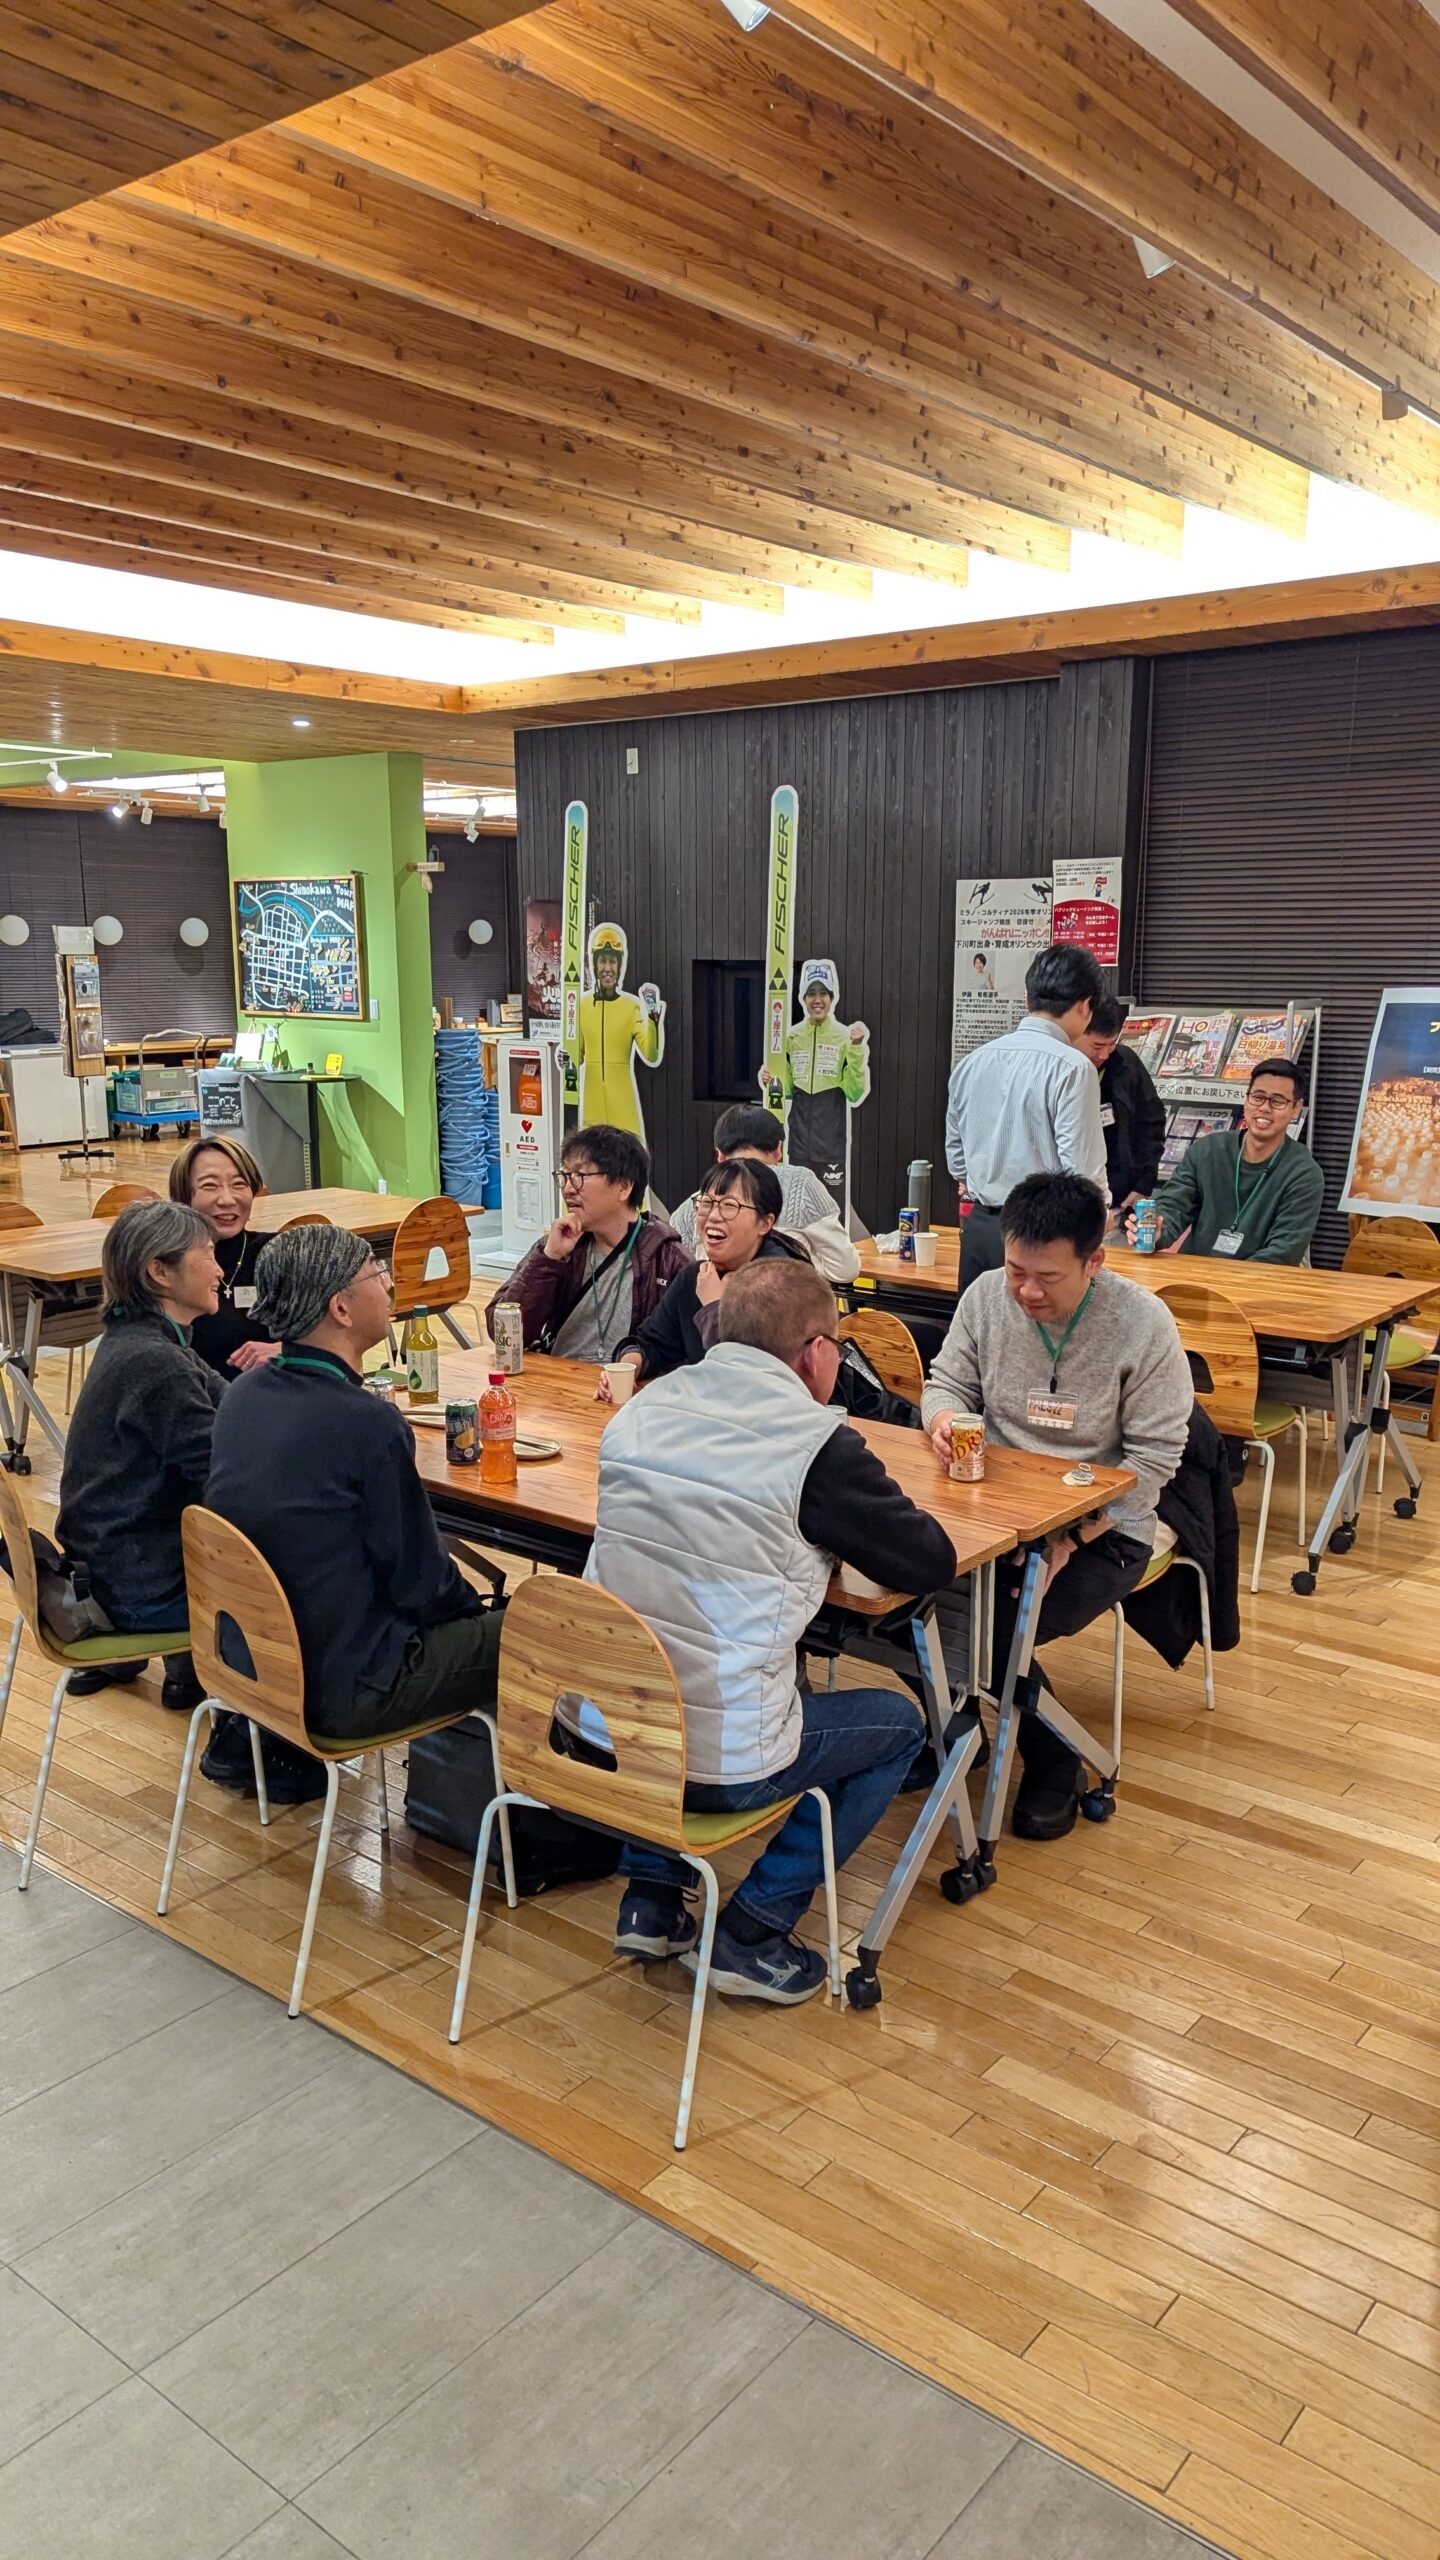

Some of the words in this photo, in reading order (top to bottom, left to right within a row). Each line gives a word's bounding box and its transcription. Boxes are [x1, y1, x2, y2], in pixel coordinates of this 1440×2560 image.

[568, 825, 580, 951] FISCHER
[774, 812, 789, 955] FISCHER
[521, 1099, 537, 1109] AED
[519, 1135, 535, 1143] AED
